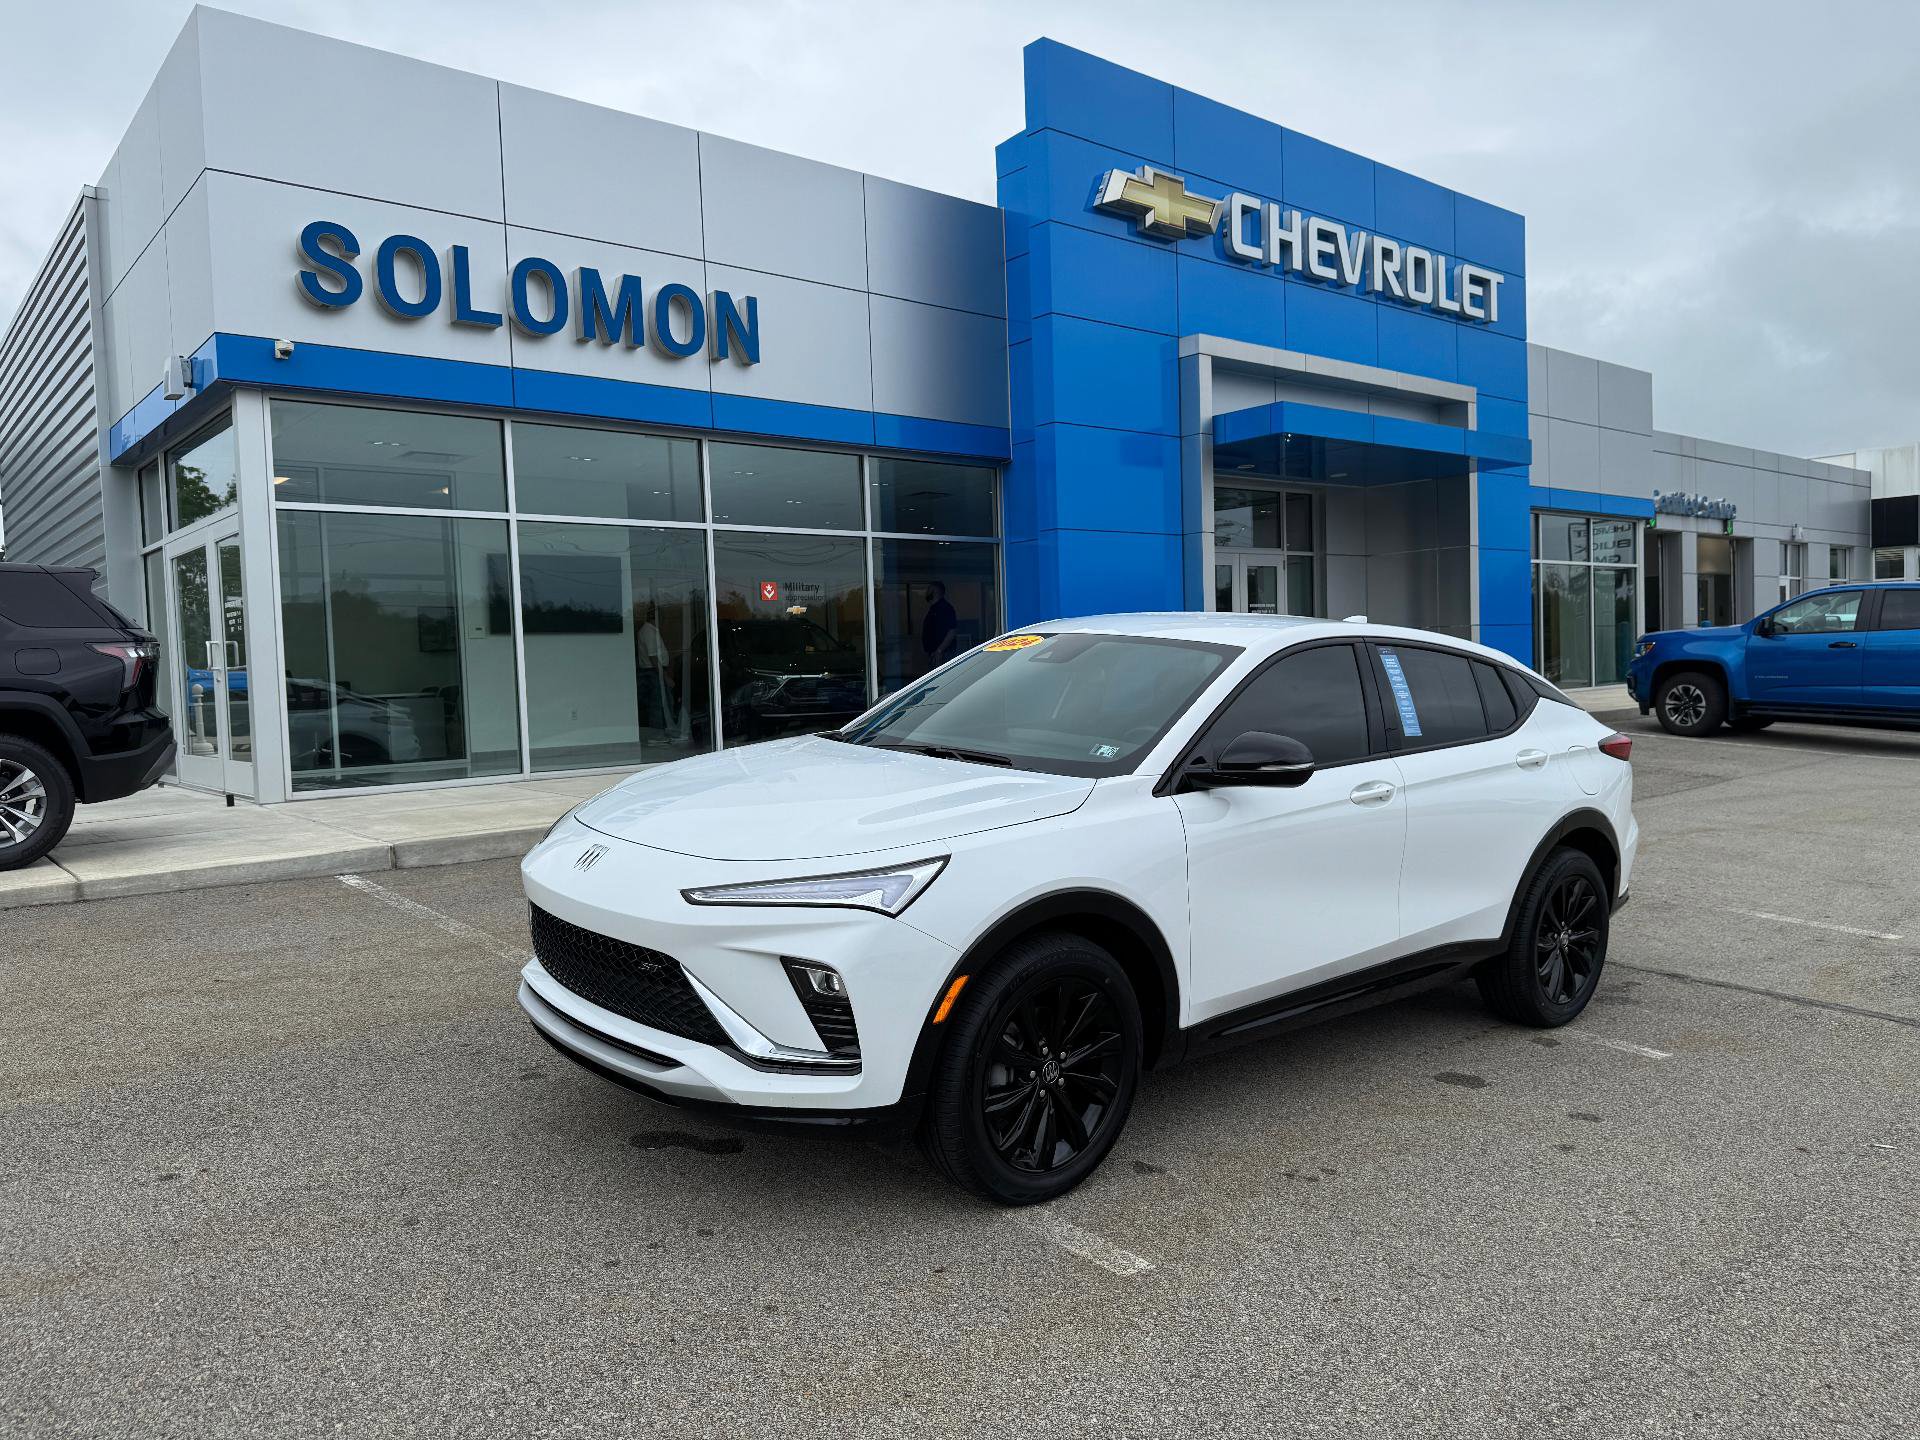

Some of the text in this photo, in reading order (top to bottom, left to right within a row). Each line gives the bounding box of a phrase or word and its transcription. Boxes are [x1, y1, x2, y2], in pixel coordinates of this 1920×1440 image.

[294, 219, 761, 367] SOLOMON
[1222, 191, 1504, 323] CHEVROLET
[784, 582, 820, 593] Military
